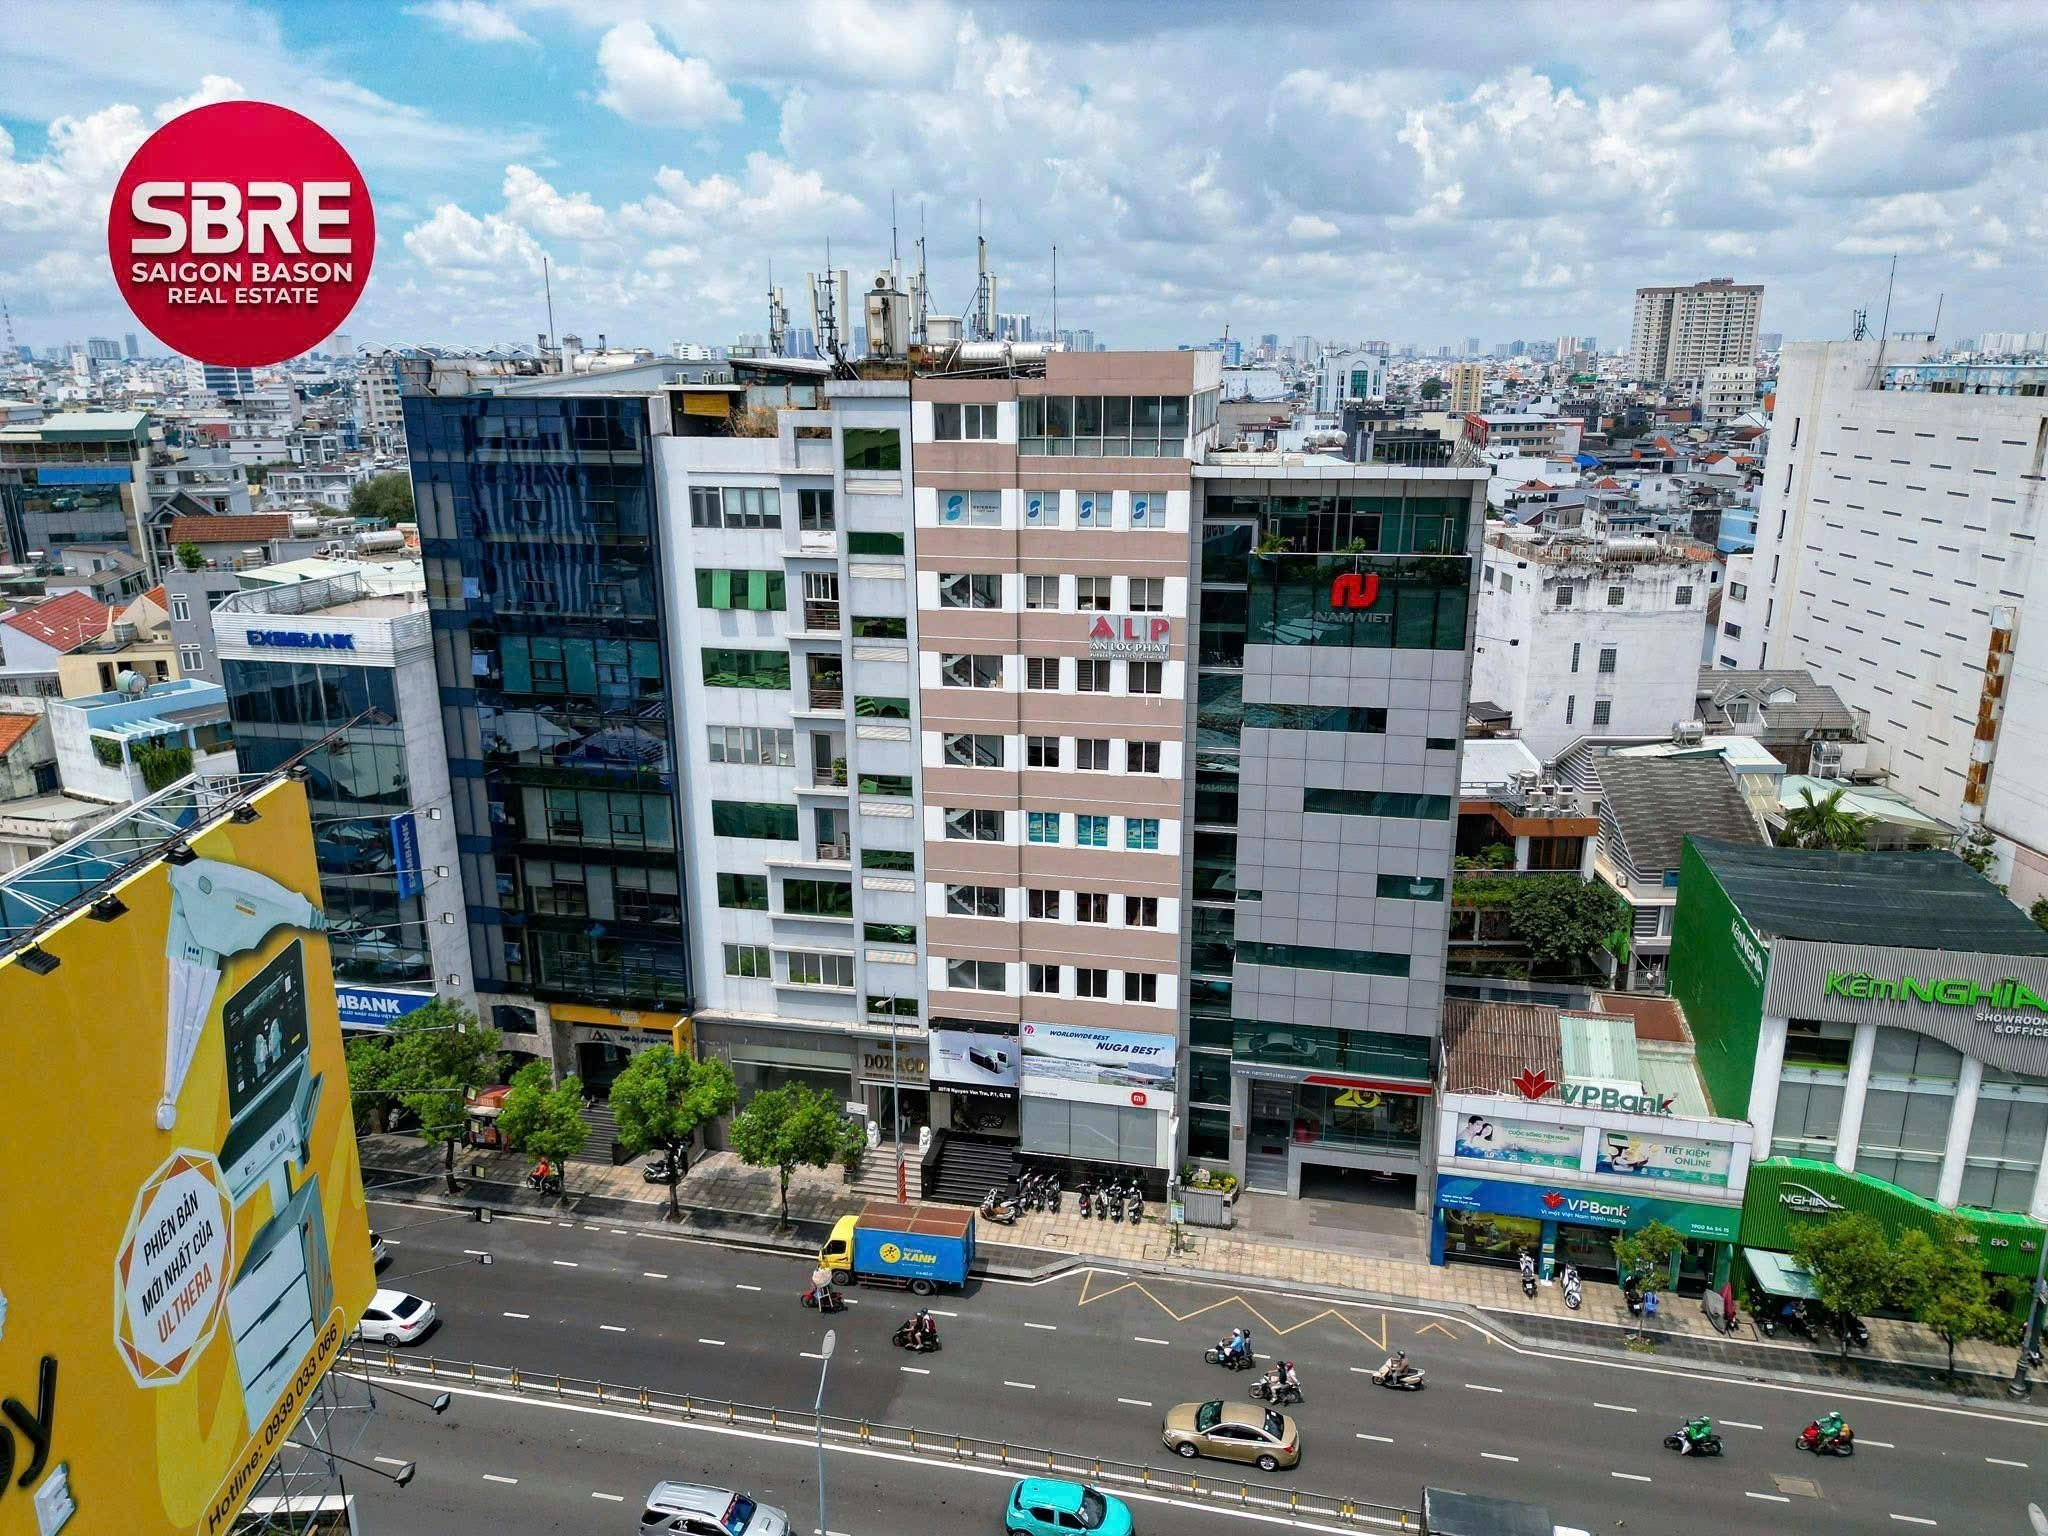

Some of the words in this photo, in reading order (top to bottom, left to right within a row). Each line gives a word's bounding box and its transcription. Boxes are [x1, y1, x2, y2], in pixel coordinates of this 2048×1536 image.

[1315, 612, 1354, 623] NAM
[1360, 613, 1392, 623] VIET
[246, 630, 355, 650] EXIMBANK
[1135, 643, 1168, 653] PHAT
[1049, 1030, 1092, 1040] WORLDWIDE
[1096, 1042, 1130, 1053] NUGA
[1131, 1046, 1161, 1056] BEST
[1560, 1083, 1676, 1115] VPBank
[1675, 1157, 1711, 1168] ONLINE
[1568, 1199, 1630, 1217] VPBank
[143, 1216, 177, 1266] PHIÊN
[176, 1190, 199, 1229] BẢN
[164, 1240, 192, 1291] NHẤT
[192, 1219, 214, 1255] CỦA
[903, 1252, 937, 1264] XANH
[208, 1445, 263, 1535] Hotline:
[265, 1393, 294, 1445] 0939
[296, 1356, 317, 1397] 033
[317, 1323, 337, 1361] 066
